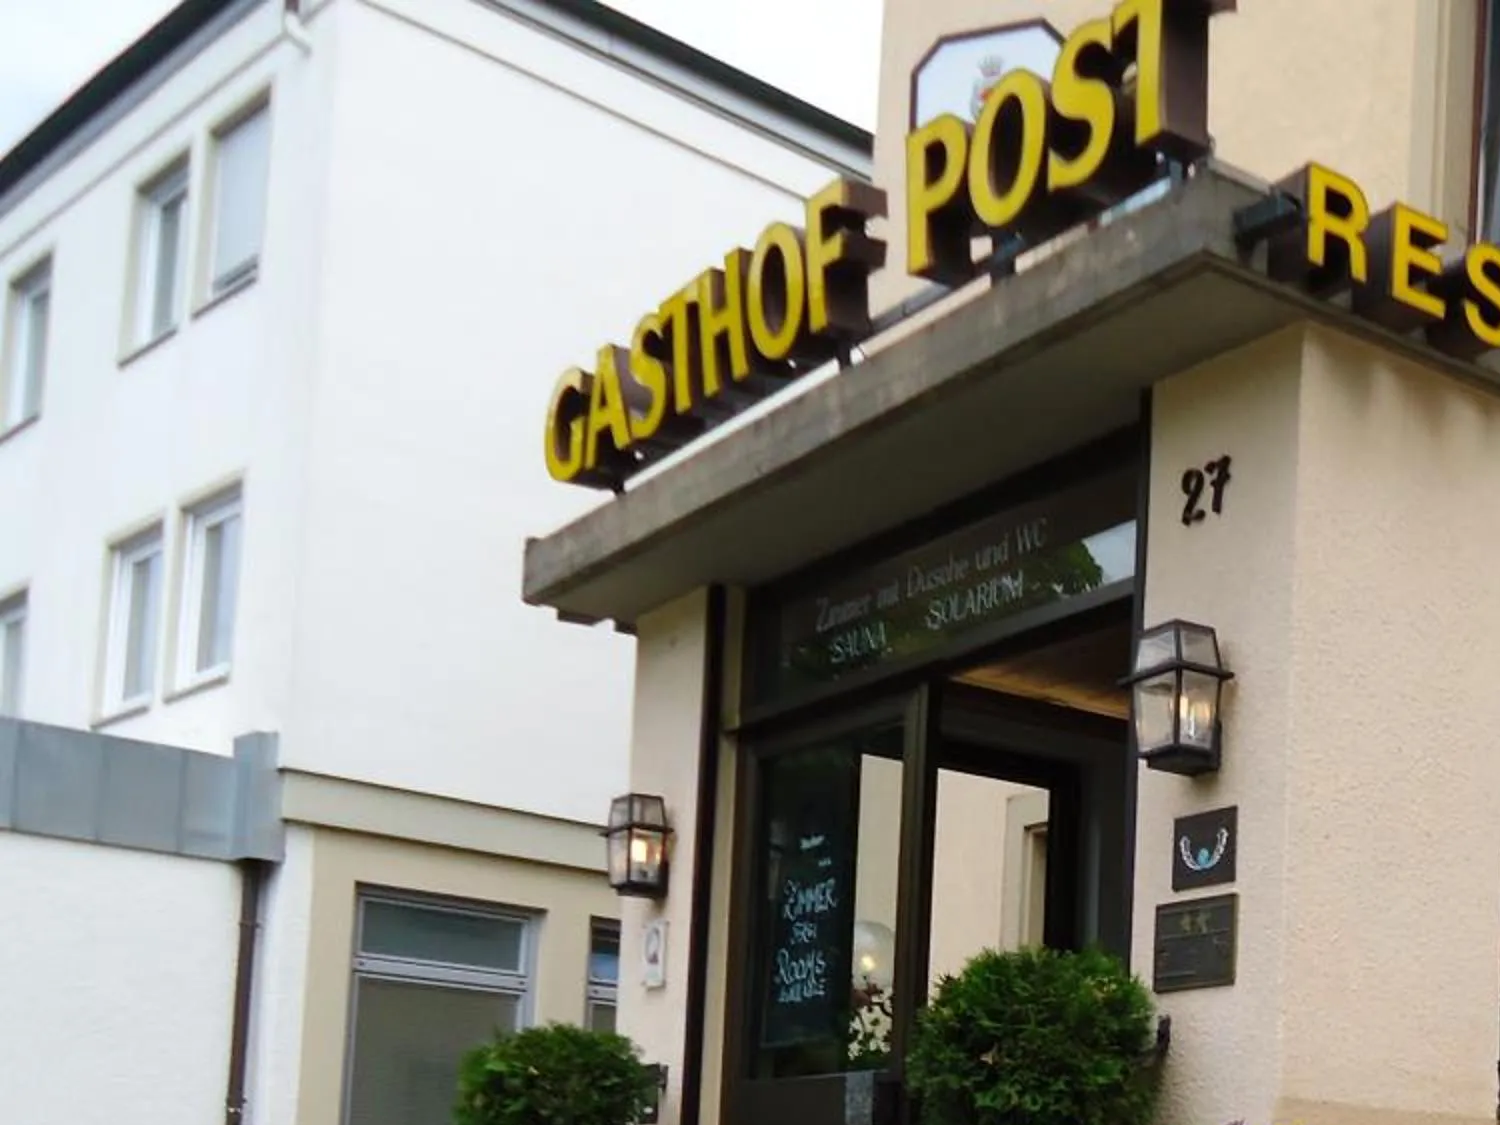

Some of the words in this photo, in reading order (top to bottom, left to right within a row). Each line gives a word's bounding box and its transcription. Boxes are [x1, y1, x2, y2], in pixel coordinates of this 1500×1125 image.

[544, 177, 848, 483] GASTHOF
[905, 0, 1165, 275] POST
[1180, 454, 1232, 526] 27
[974, 532, 1010, 572] und
[924, 568, 1025, 631] SOLARIUM
